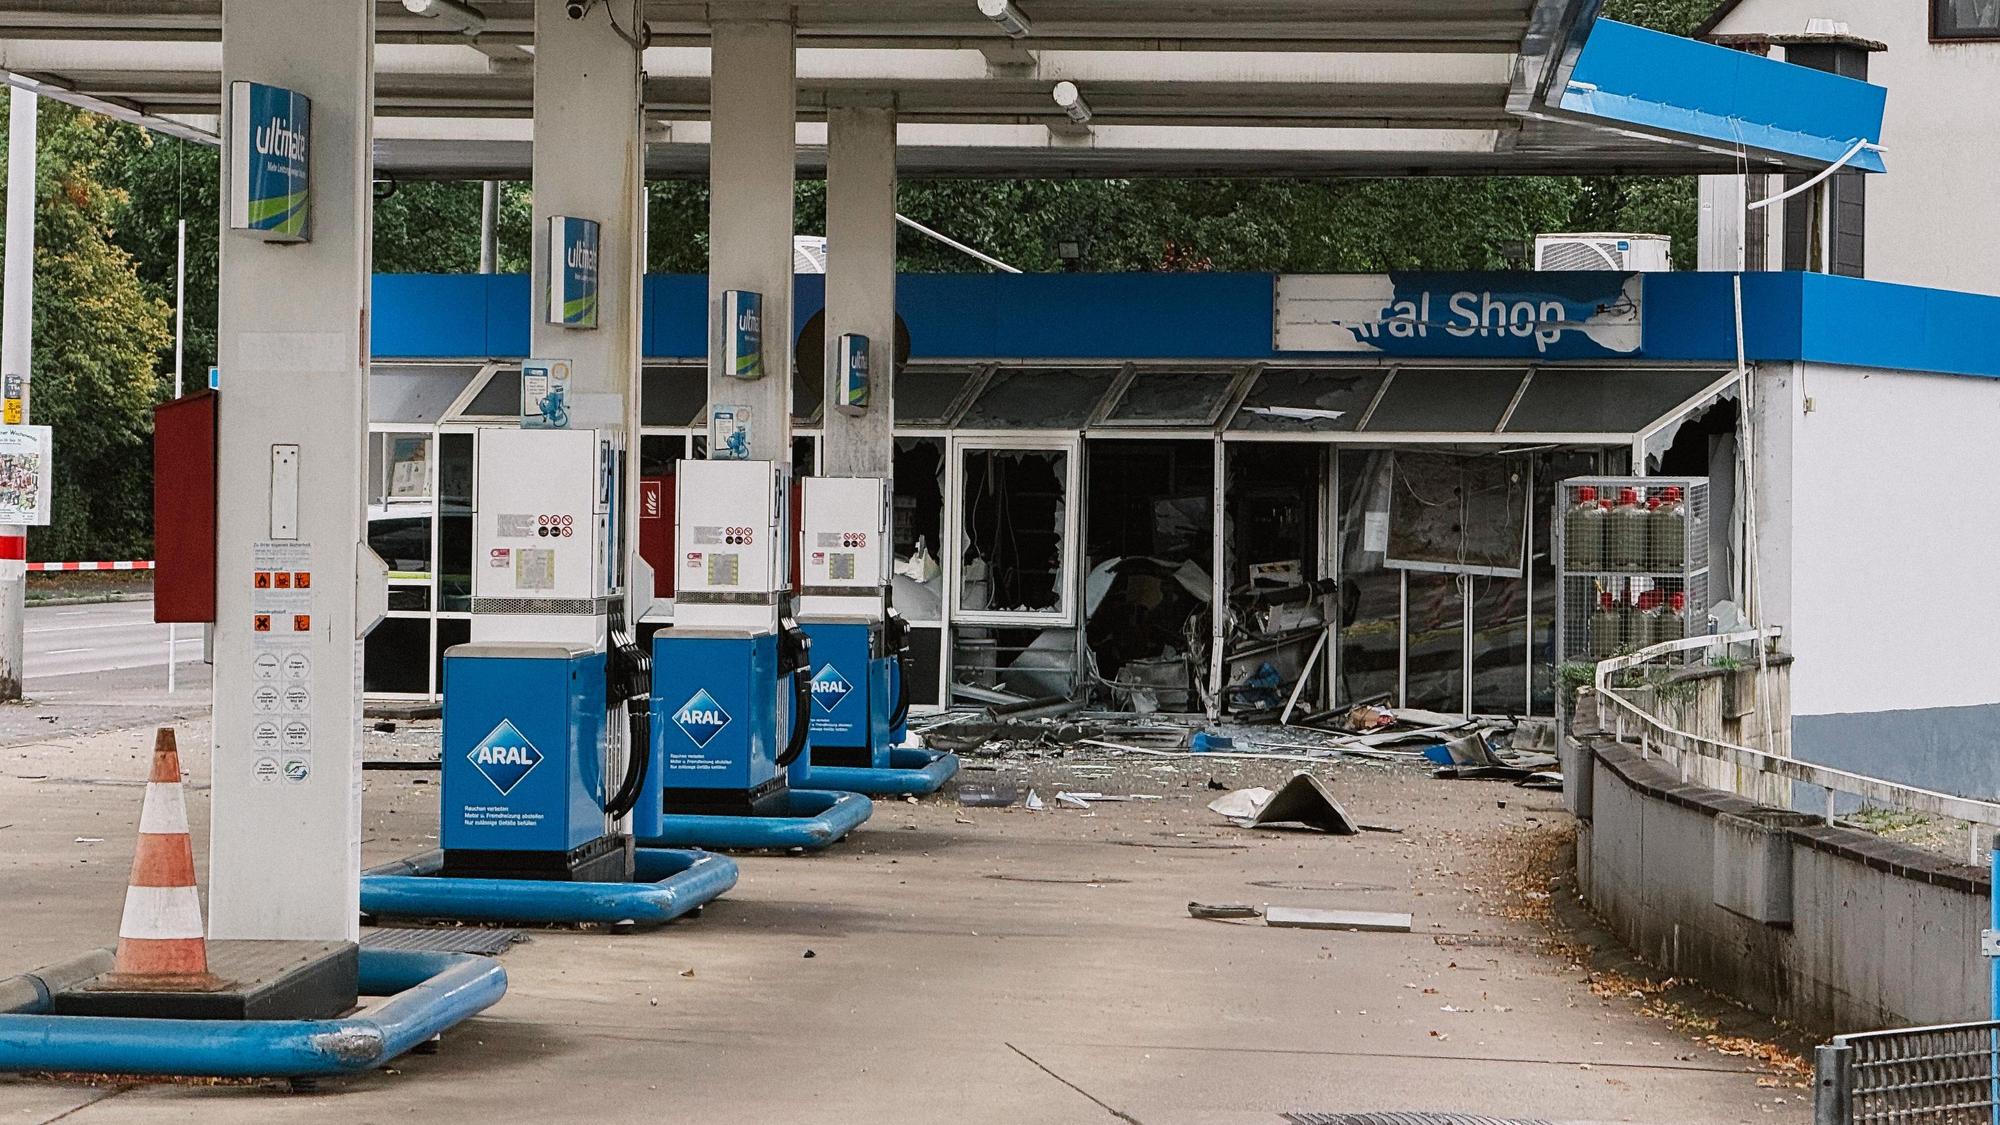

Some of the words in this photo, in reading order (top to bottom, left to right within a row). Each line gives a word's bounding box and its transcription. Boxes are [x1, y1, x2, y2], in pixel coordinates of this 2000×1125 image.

[256, 116, 305, 162] ultimate
[1445, 291, 1565, 352] Shop
[811, 681, 846, 692] ARAL
[680, 710, 723, 724] ARAL
[478, 746, 533, 764] ARAL
